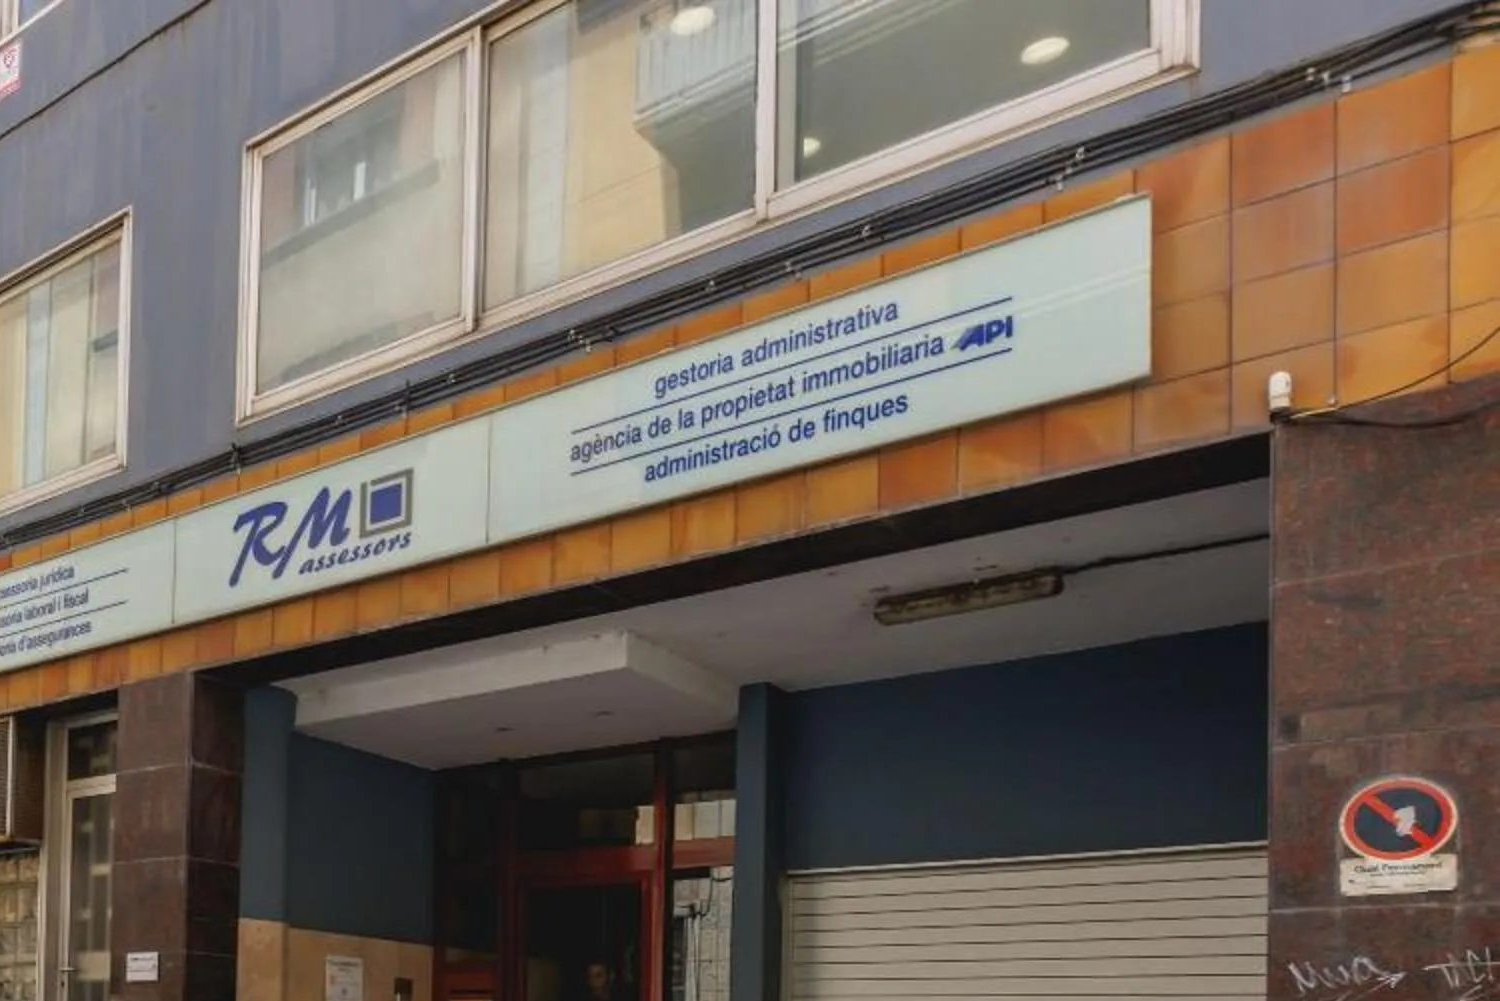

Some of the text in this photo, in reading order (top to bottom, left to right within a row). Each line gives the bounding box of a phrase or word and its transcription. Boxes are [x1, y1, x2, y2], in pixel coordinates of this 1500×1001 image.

[570, 315, 1014, 464] agència de la propietat immobiliaria API
[655, 301, 899, 398] gestoria administrativa
[644, 392, 909, 483] administració de finques
[228, 486, 353, 588] RM
[299, 532, 412, 575] assessors
[24, 599, 56, 621] laboral
[63, 586, 89, 609] fiscal
